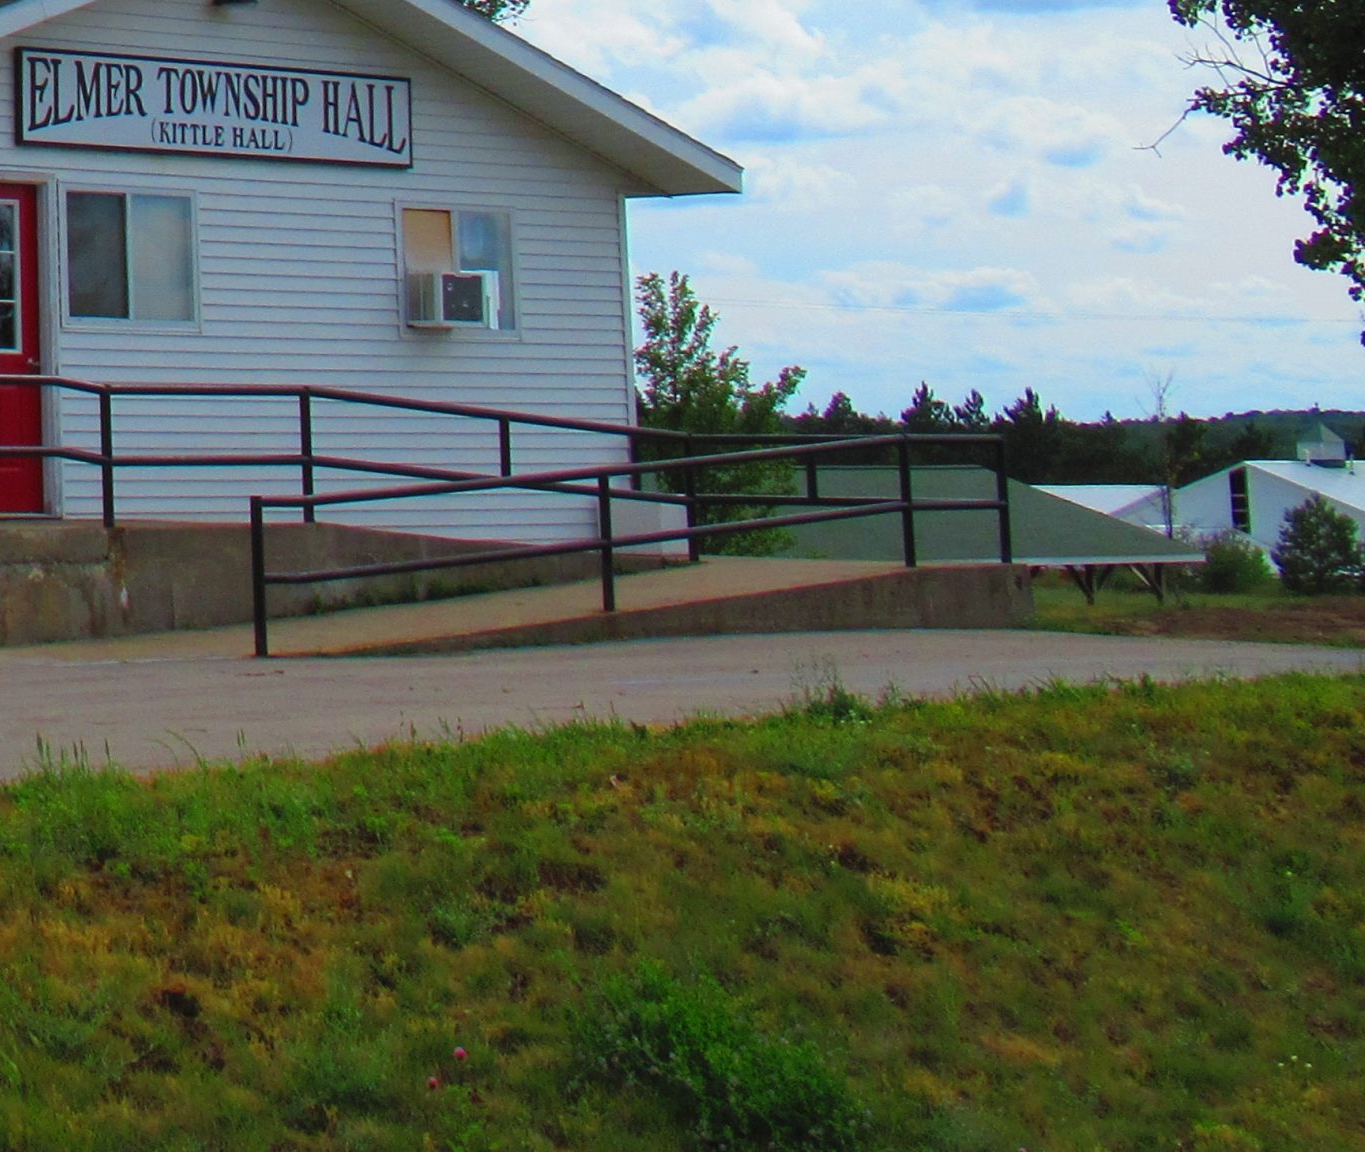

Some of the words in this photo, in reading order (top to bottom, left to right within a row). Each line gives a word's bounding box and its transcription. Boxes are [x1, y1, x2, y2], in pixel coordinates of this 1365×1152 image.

[27, 56, 147, 132] ELMER
[157, 66, 310, 127] TOWNSHIP
[322, 79, 407, 155] HALL
[151, 121, 225, 148] (KITTLE
[232, 127, 294, 152] HALL)
